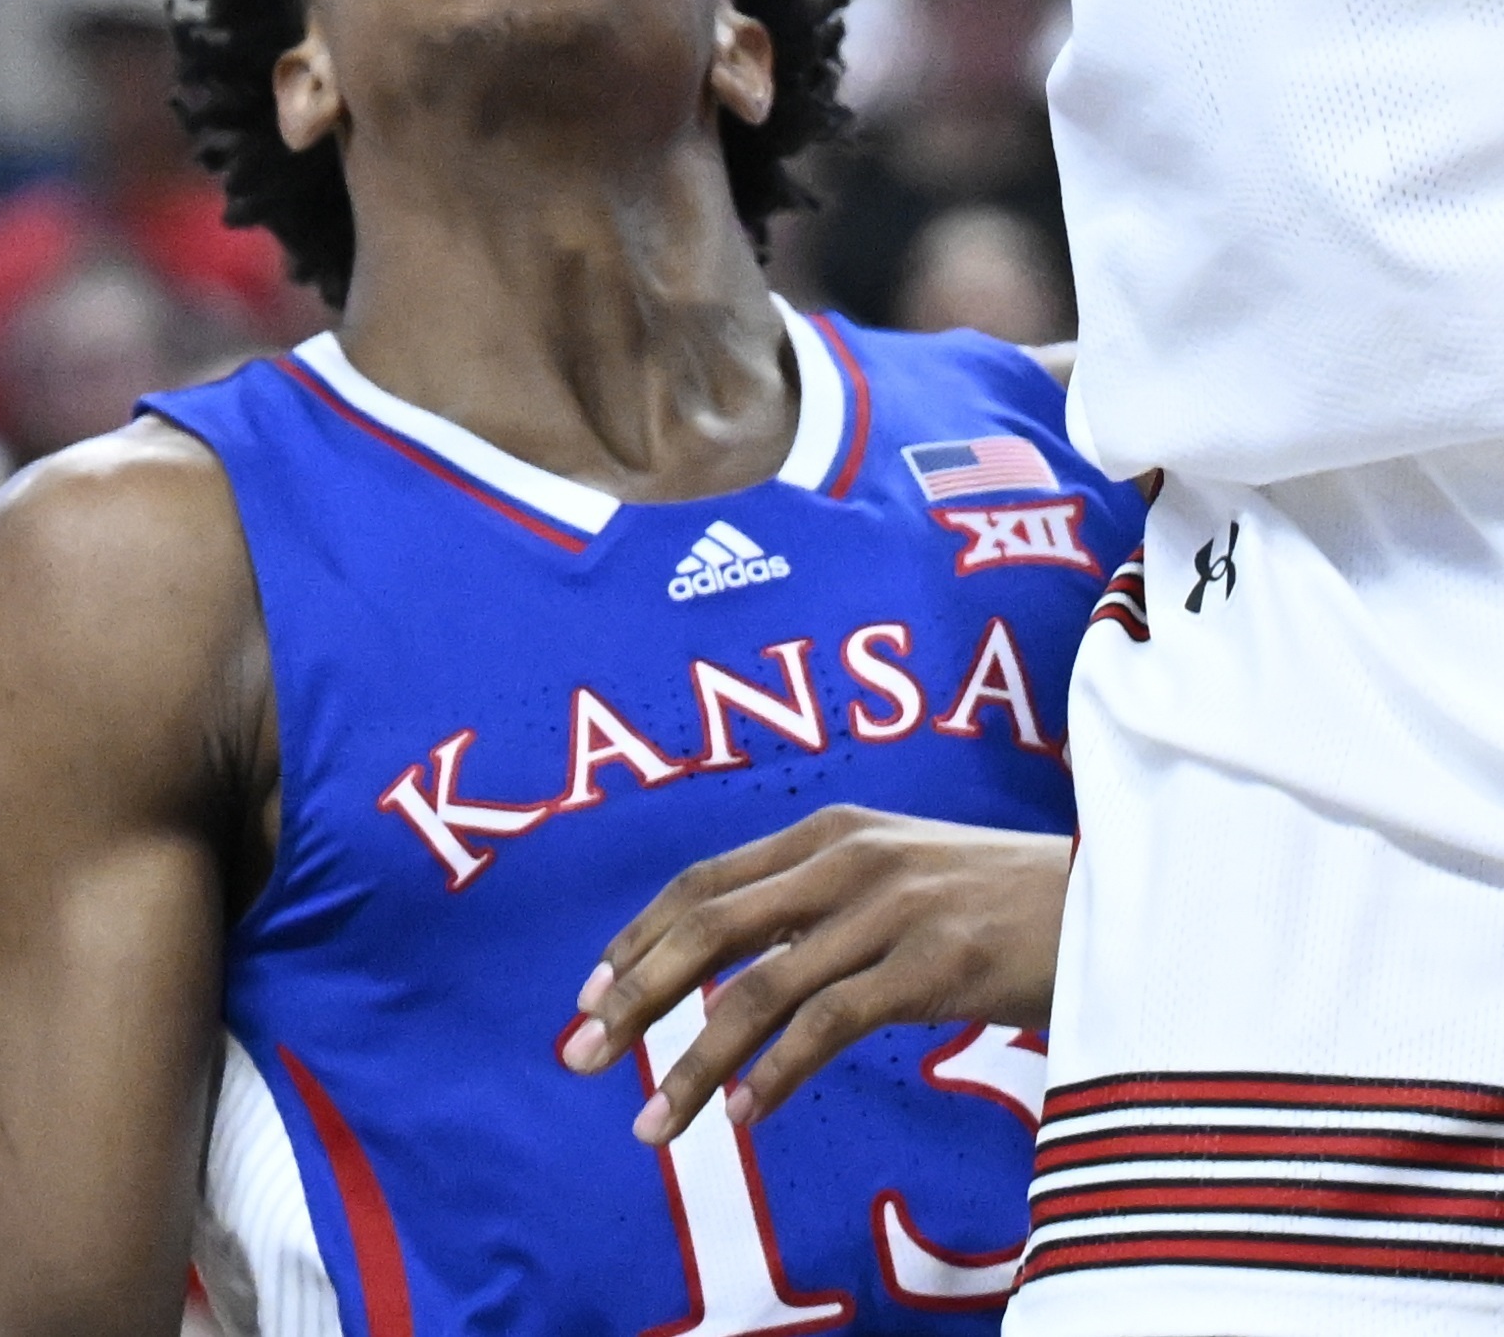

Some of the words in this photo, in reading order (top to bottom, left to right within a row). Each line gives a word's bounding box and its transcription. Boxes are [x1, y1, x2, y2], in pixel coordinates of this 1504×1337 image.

[938, 500, 1096, 571] XII
[667, 553, 791, 603] adidas
[378, 617, 1073, 893] KANSA
